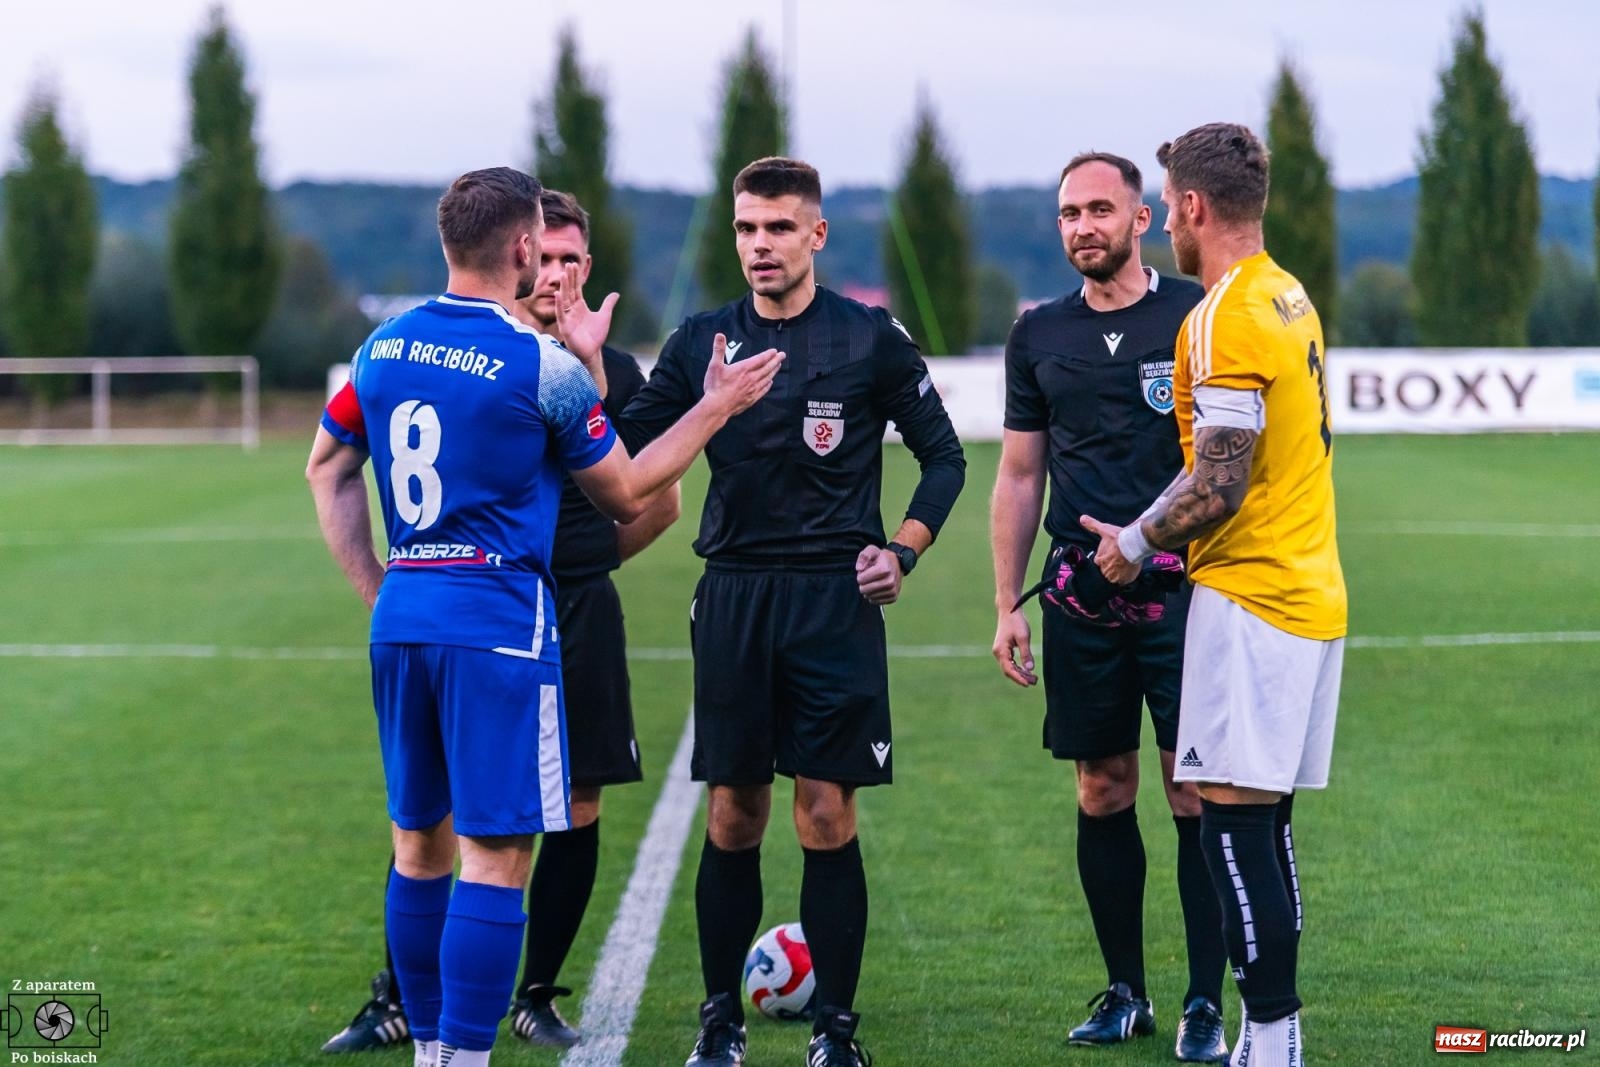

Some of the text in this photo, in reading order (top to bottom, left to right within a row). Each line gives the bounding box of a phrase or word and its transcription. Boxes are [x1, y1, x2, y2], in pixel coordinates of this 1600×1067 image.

[370, 338, 505, 380] UNIA RACIBÓRZ
[1348, 369, 1536, 413] BOXY
[389, 400, 442, 531] 8
